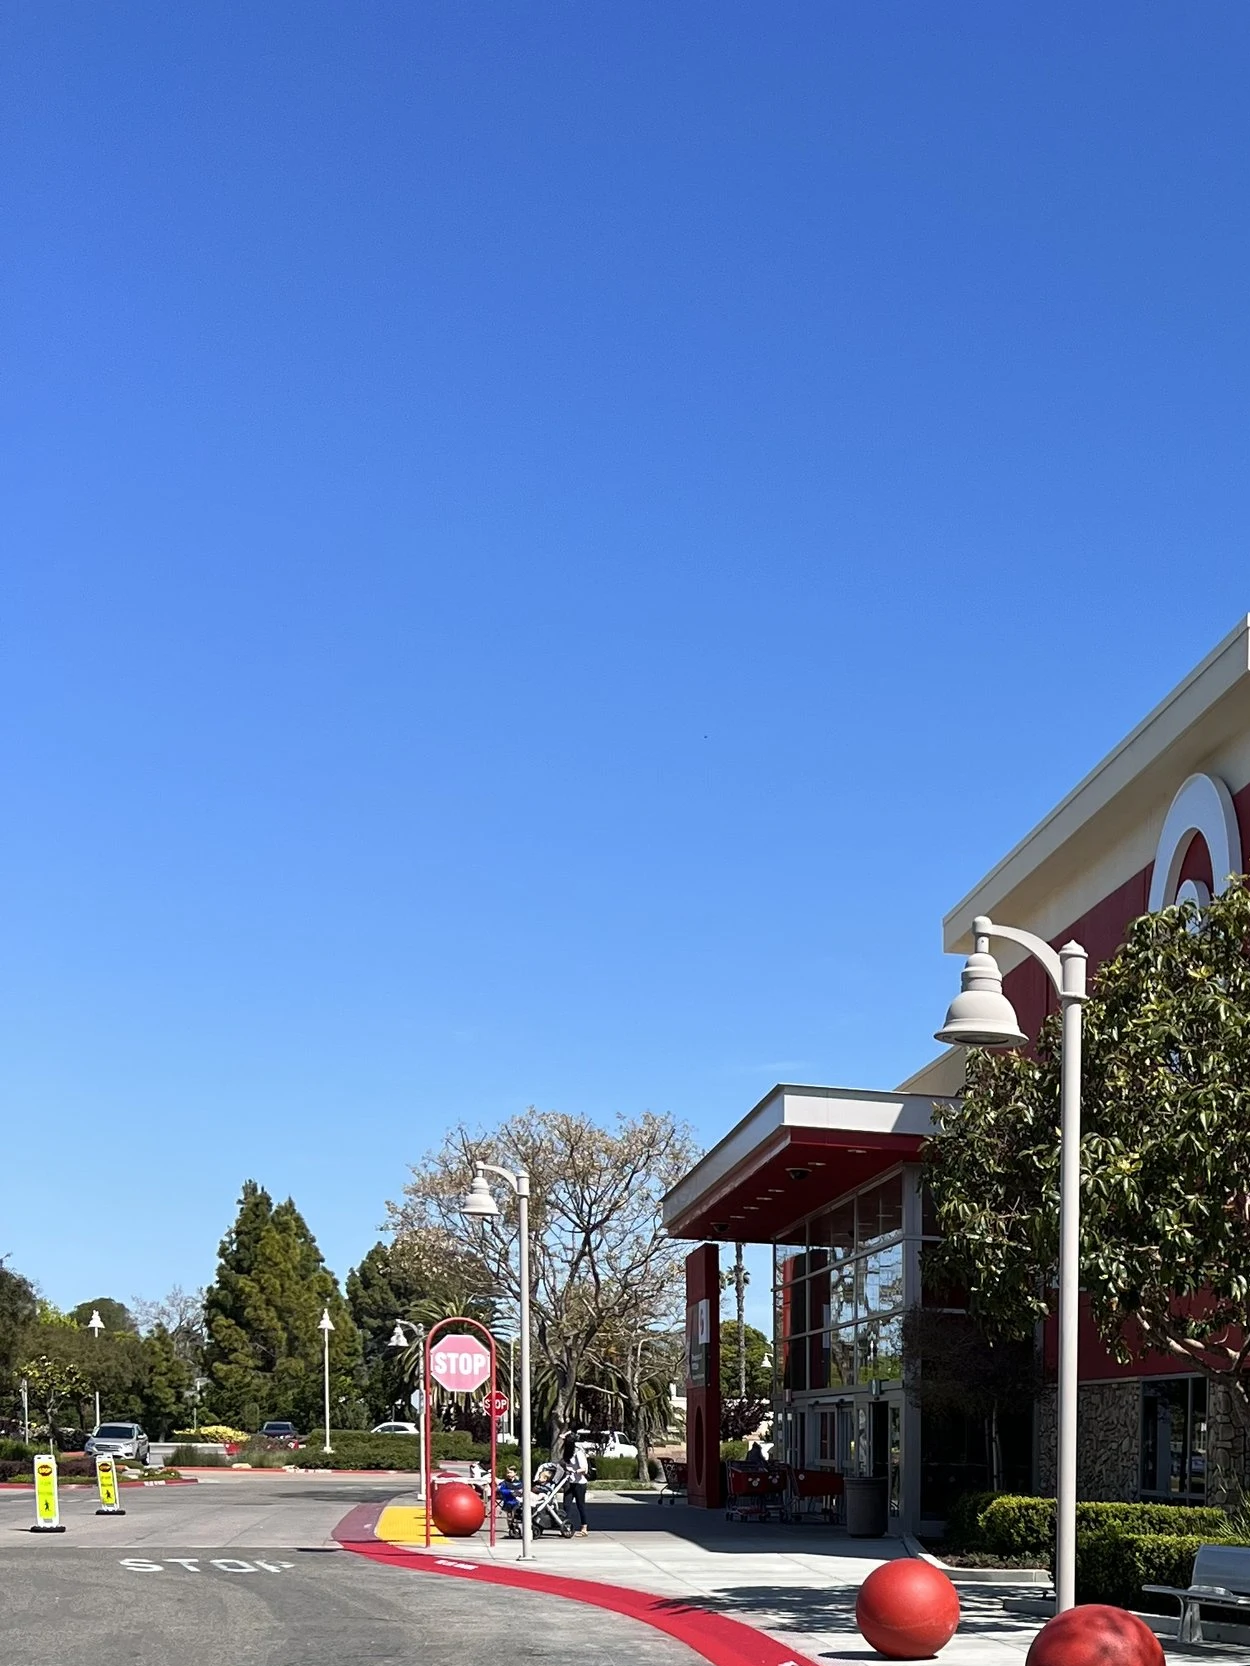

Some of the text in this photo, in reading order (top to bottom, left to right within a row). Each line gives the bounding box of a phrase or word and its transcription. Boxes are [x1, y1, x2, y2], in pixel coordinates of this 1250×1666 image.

[434, 1352, 486, 1375] STOP
[485, 1400, 507, 1409] SOP
[119, 1558, 295, 1573] STOP
